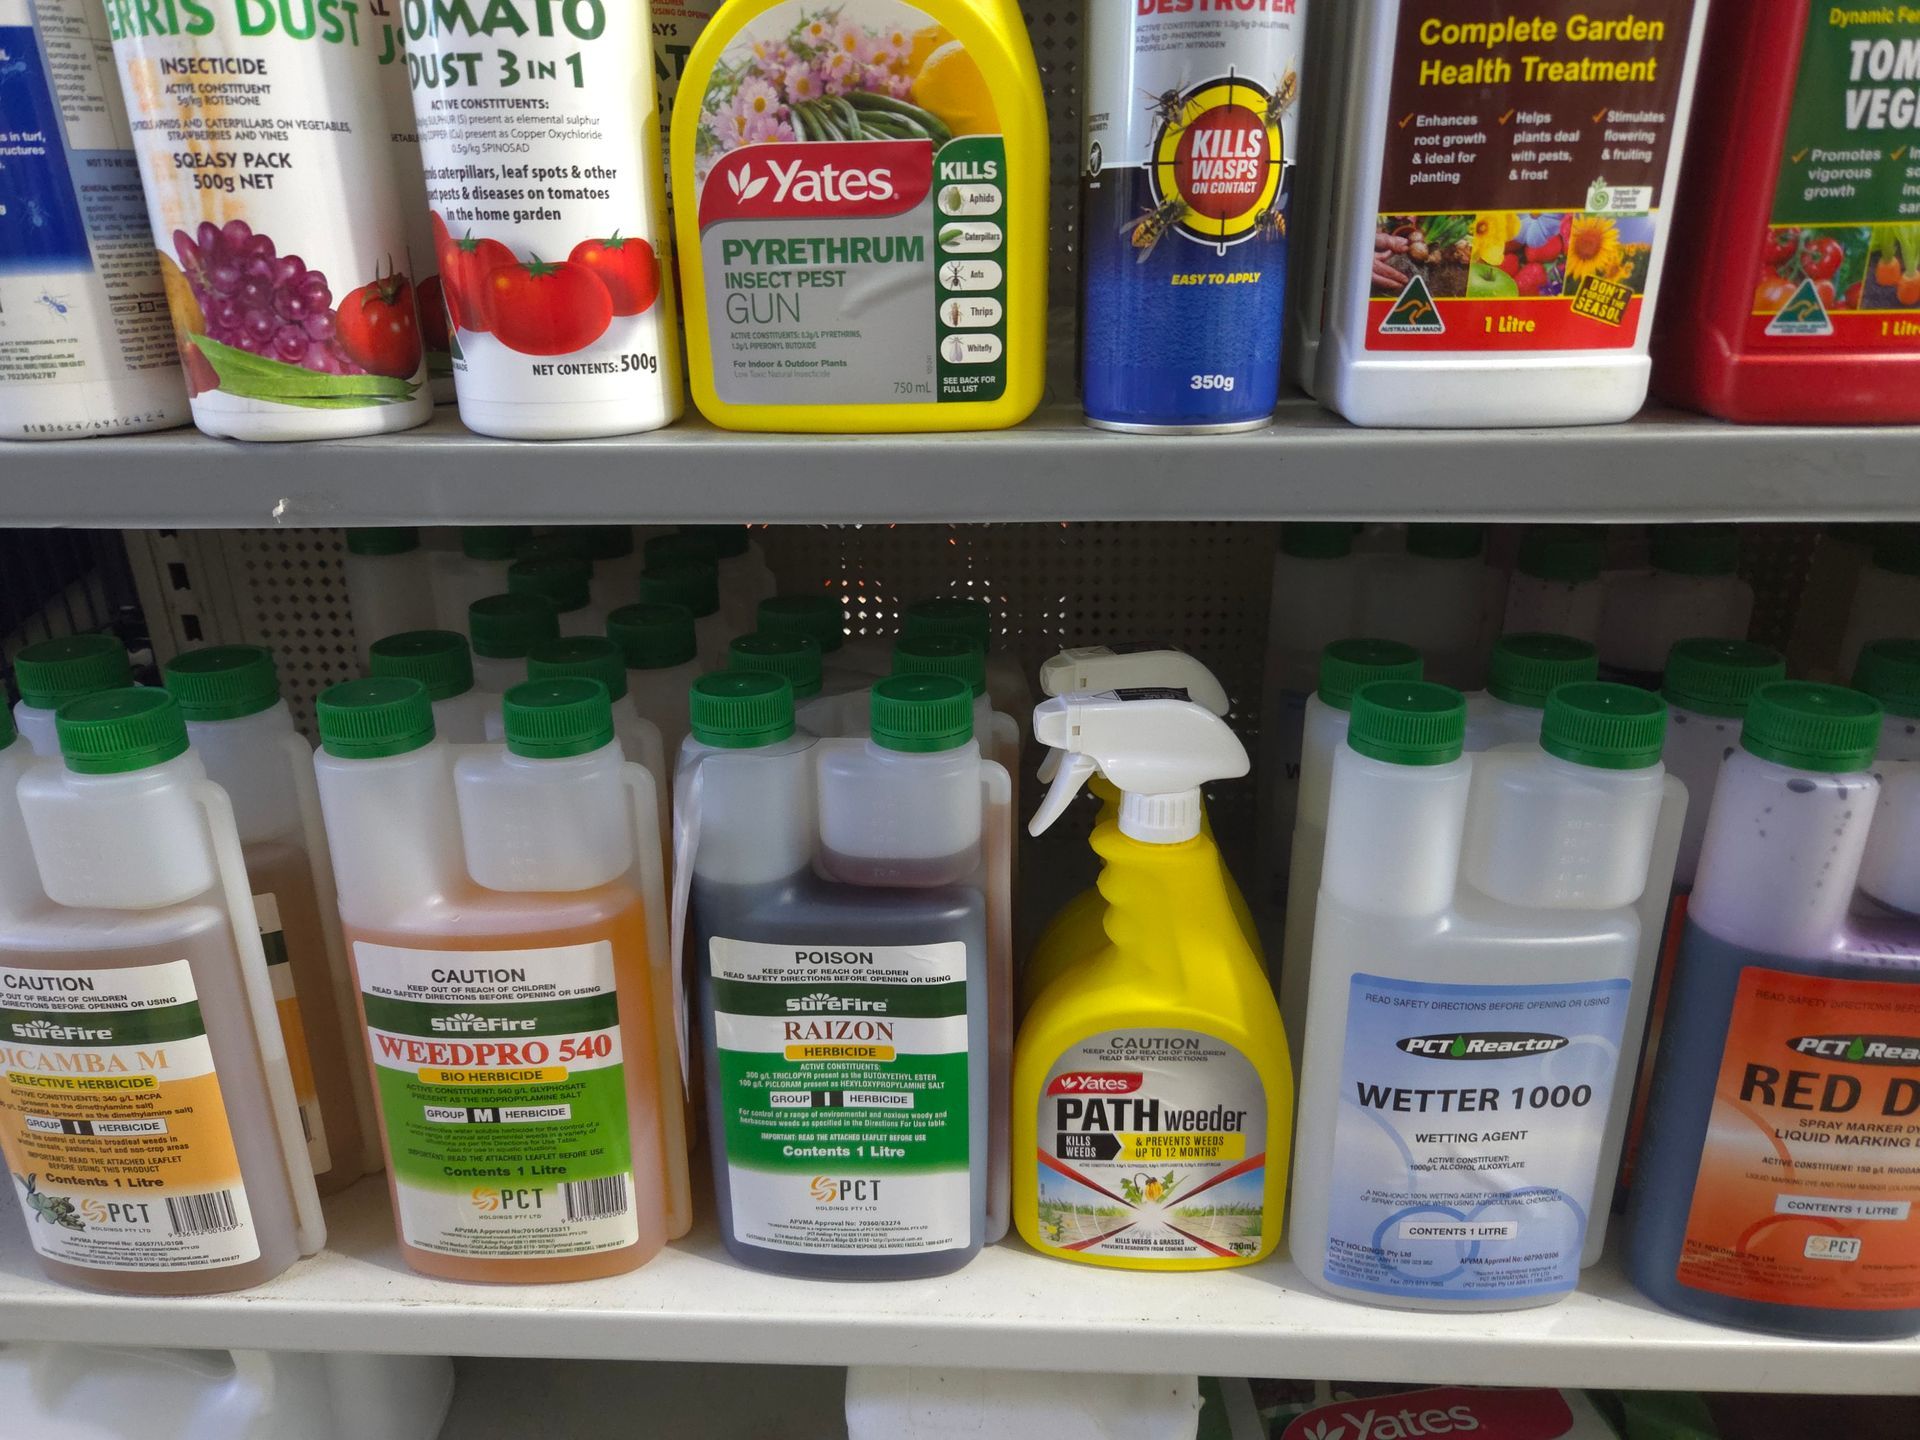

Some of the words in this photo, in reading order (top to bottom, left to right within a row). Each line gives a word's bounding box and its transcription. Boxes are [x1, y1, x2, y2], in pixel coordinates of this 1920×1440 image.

[236, 0, 360, 47] DUST
[1829, 7, 1895, 28] Dynamic
[1419, 16, 1558, 49] Complete
[1566, 15, 1665, 42] Garden
[160, 58, 268, 75] INSECTICIDE
[407, 52, 483, 91] DUST
[499, 49, 521, 88] 3
[527, 60, 556, 80] IN
[565, 52, 584, 88] 1
[1419, 58, 1511, 86] Health
[1521, 56, 1657, 83] Treatment
[165, 83, 196, 94] ACTIVE
[200, 83, 271, 94] CONSTITUENT
[1846, 87, 1920, 129] VEG
[1416, 114, 1478, 127] Enhances
[1516, 112, 1552, 126] Helps
[1606, 111, 1665, 123] Stimulates
[183, 118, 203, 130] AND
[205, 118, 276, 131] CATERPILLARS
[278, 119, 293, 131] ON
[295, 120, 352, 134] VEGETABLES,
[1191, 129, 1263, 159] KILLS
[1414, 134, 1440, 146] root
[1442, 132, 1486, 148] growth
[1604, 131, 1656, 144] flowering
[173, 152, 237, 169] SQEASY
[244, 152, 293, 169] PACK
[1811, 149, 1881, 162] Promotes
[438, 165, 500, 182] caterpillars,
[502, 164, 529, 179] leaf
[531, 166, 569, 182] spots
[571, 165, 582, 179] &
[584, 165, 617, 179] other
[940, 161, 997, 180] KILLS
[1191, 159, 1258, 180] WASPS
[1808, 168, 1872, 183] vigorous
[193, 174, 235, 192] 500g
[240, 174, 274, 190] NET
[766, 159, 894, 202] Yates
[1191, 182, 1208, 195] ON
[1210, 181, 1257, 195] CONTACT
[969, 193, 995, 204] Aphids
[1804, 185, 1855, 201] growth
[965, 231, 1001, 243] Caterpillars
[722, 236, 924, 266] PYRETHRUM
[725, 271, 793, 289] INSECT
[798, 271, 846, 287] PEST
[970, 270, 985, 280] Ants
[1171, 273, 1206, 285] EASY
[1208, 273, 1224, 284] TO
[1225, 272, 1261, 284] APPLY
[726, 292, 801, 324] GUN
[970, 306, 994, 318] Thrips
[967, 343, 993, 354] Whitefly
[532, 364, 554, 376] NET
[557, 363, 618, 376] CONTENTS:
[620, 353, 658, 374] 500g
[733, 360, 746, 368] For
[749, 360, 774, 368] Indoor
[776, 360, 782, 368] &
[785, 359, 818, 368] Outdoor
[821, 359, 847, 367] Plants
[893, 382, 913, 394] 750
[915, 381, 932, 394] mL
[943, 376, 959, 385] SEE
[959, 376, 979, 385] BACK
[981, 375, 996, 384] FOR
[1190, 375, 1235, 392] 350g
[943, 385, 961, 394] FULL
[962, 385, 978, 393] LIST
[795, 952, 873, 965] POISON
[3, 974, 95, 991] CAUTION
[431, 968, 526, 983] CAUTION
[723, 971, 745, 979] READ
[780, 975, 831, 983] DIRECTIONS
[924, 975, 951, 983] USING
[511, 983, 556, 992] CHILDREN
[786, 997, 888, 1012] SureFire
[431, 1017, 536, 1032] SureFire
[784, 1021, 894, 1041] RAIZON
[376, 1033, 549, 1066] WEEDPRO
[559, 1034, 612, 1062] 540
[1110, 1037, 1199, 1049] CAUTION
[1406, 1039, 1454, 1053] PCT
[1466, 1037, 1564, 1053] Reactor
[1796, 1037, 1852, 1055] PCT
[1864, 1042, 1920, 1061] Rea
[133, 1049, 170, 1070] M
[804, 1047, 877, 1057] HERBICIDE
[800, 1063, 825, 1071] ACTIVE
[827, 1063, 881, 1071] CONSTITUENTS:
[9, 1074, 74, 1089] SELECTIVE
[77, 1077, 154, 1089] HERBICIDE
[440, 1071, 466, 1082] BIO
[468, 1070, 543, 1082] HERBICIDE
[1078, 1076, 1128, 1090] Yates
[1739, 1063, 1862, 1113] RED
[1357, 1081, 1500, 1113] WETTER
[1511, 1084, 1591, 1110] 1000
[427, 1109, 464, 1119] GROUP
[474, 1108, 493, 1123] M
[505, 1107, 566, 1119] HERBICIDE
[1057, 1098, 1159, 1132] PATH
[1164, 1104, 1247, 1132] weeder
[1799, 1118, 1844, 1131] SPRAY
[1846, 1121, 1902, 1134] MARKER
[1066, 1135, 1091, 1146] KILLS
[1136, 1138, 1143, 1146] &
[1145, 1136, 1191, 1146] PREVENTS
[1194, 1136, 1224, 1146] WEEDS
[1415, 1132, 1478, 1143] WETTING
[1481, 1130, 1528, 1142] AGENT
[1775, 1128, 1830, 1145] LIQUID
[1835, 1133, 1911, 1148] MARKING
[783, 1146, 850, 1157] Contents
[857, 1146, 863, 1157] 1
[870, 1146, 905, 1157] Litre
[1065, 1147, 1096, 1158] WEEDS
[839, 1179, 881, 1201] PCT
[501, 1188, 543, 1210] PCT
[110, 1203, 150, 1223] PCT
[1409, 1226, 1467, 1236] CONTENTS
[1470, 1227, 1475, 1236] 1
[1478, 1226, 1508, 1236] LITRE
[1159, 1238, 1185, 1246] GRASSES
[1229, 1242, 1257, 1250] 750mL
[1828, 1240, 1857, 1254] PCT
[1341, 1403, 1479, 1440] Yates
